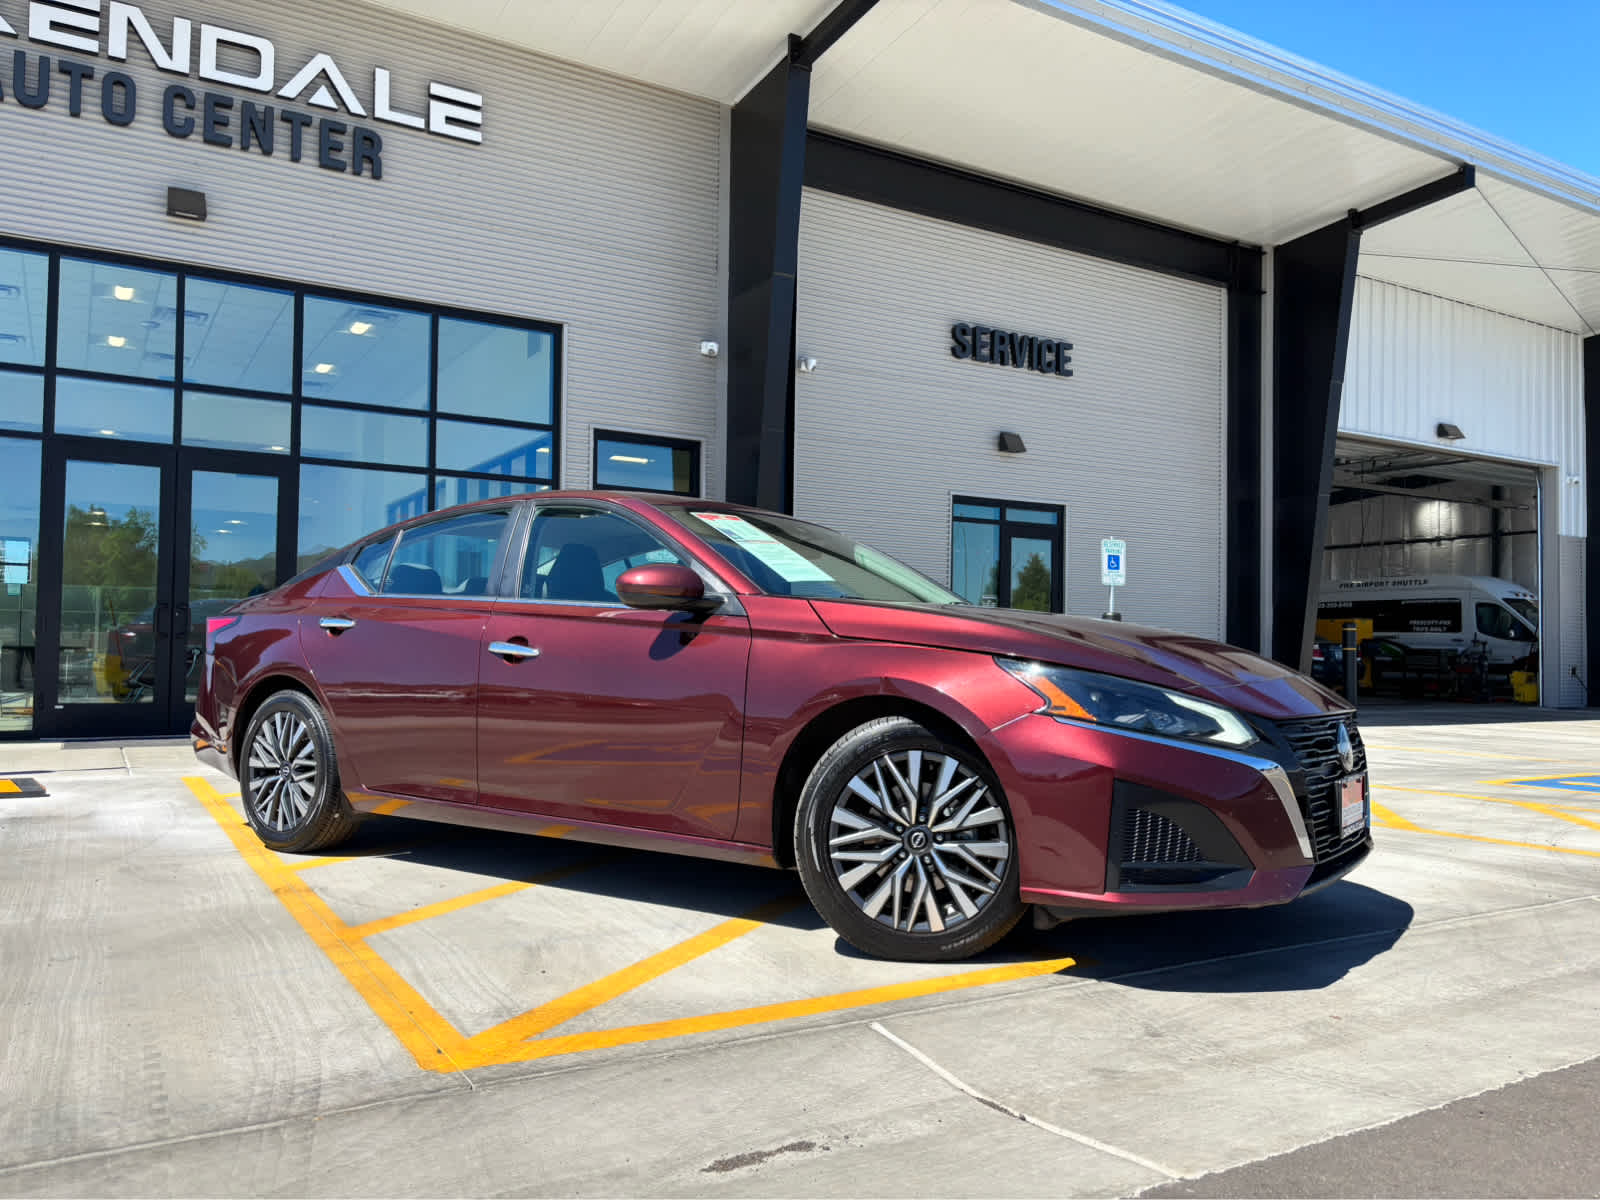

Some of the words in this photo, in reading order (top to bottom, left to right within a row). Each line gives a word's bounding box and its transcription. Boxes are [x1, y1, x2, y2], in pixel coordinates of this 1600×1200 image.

[0, 50, 136, 127] UTO
[162, 84, 384, 180] CENTER
[950, 322, 1074, 377] SERVICE
